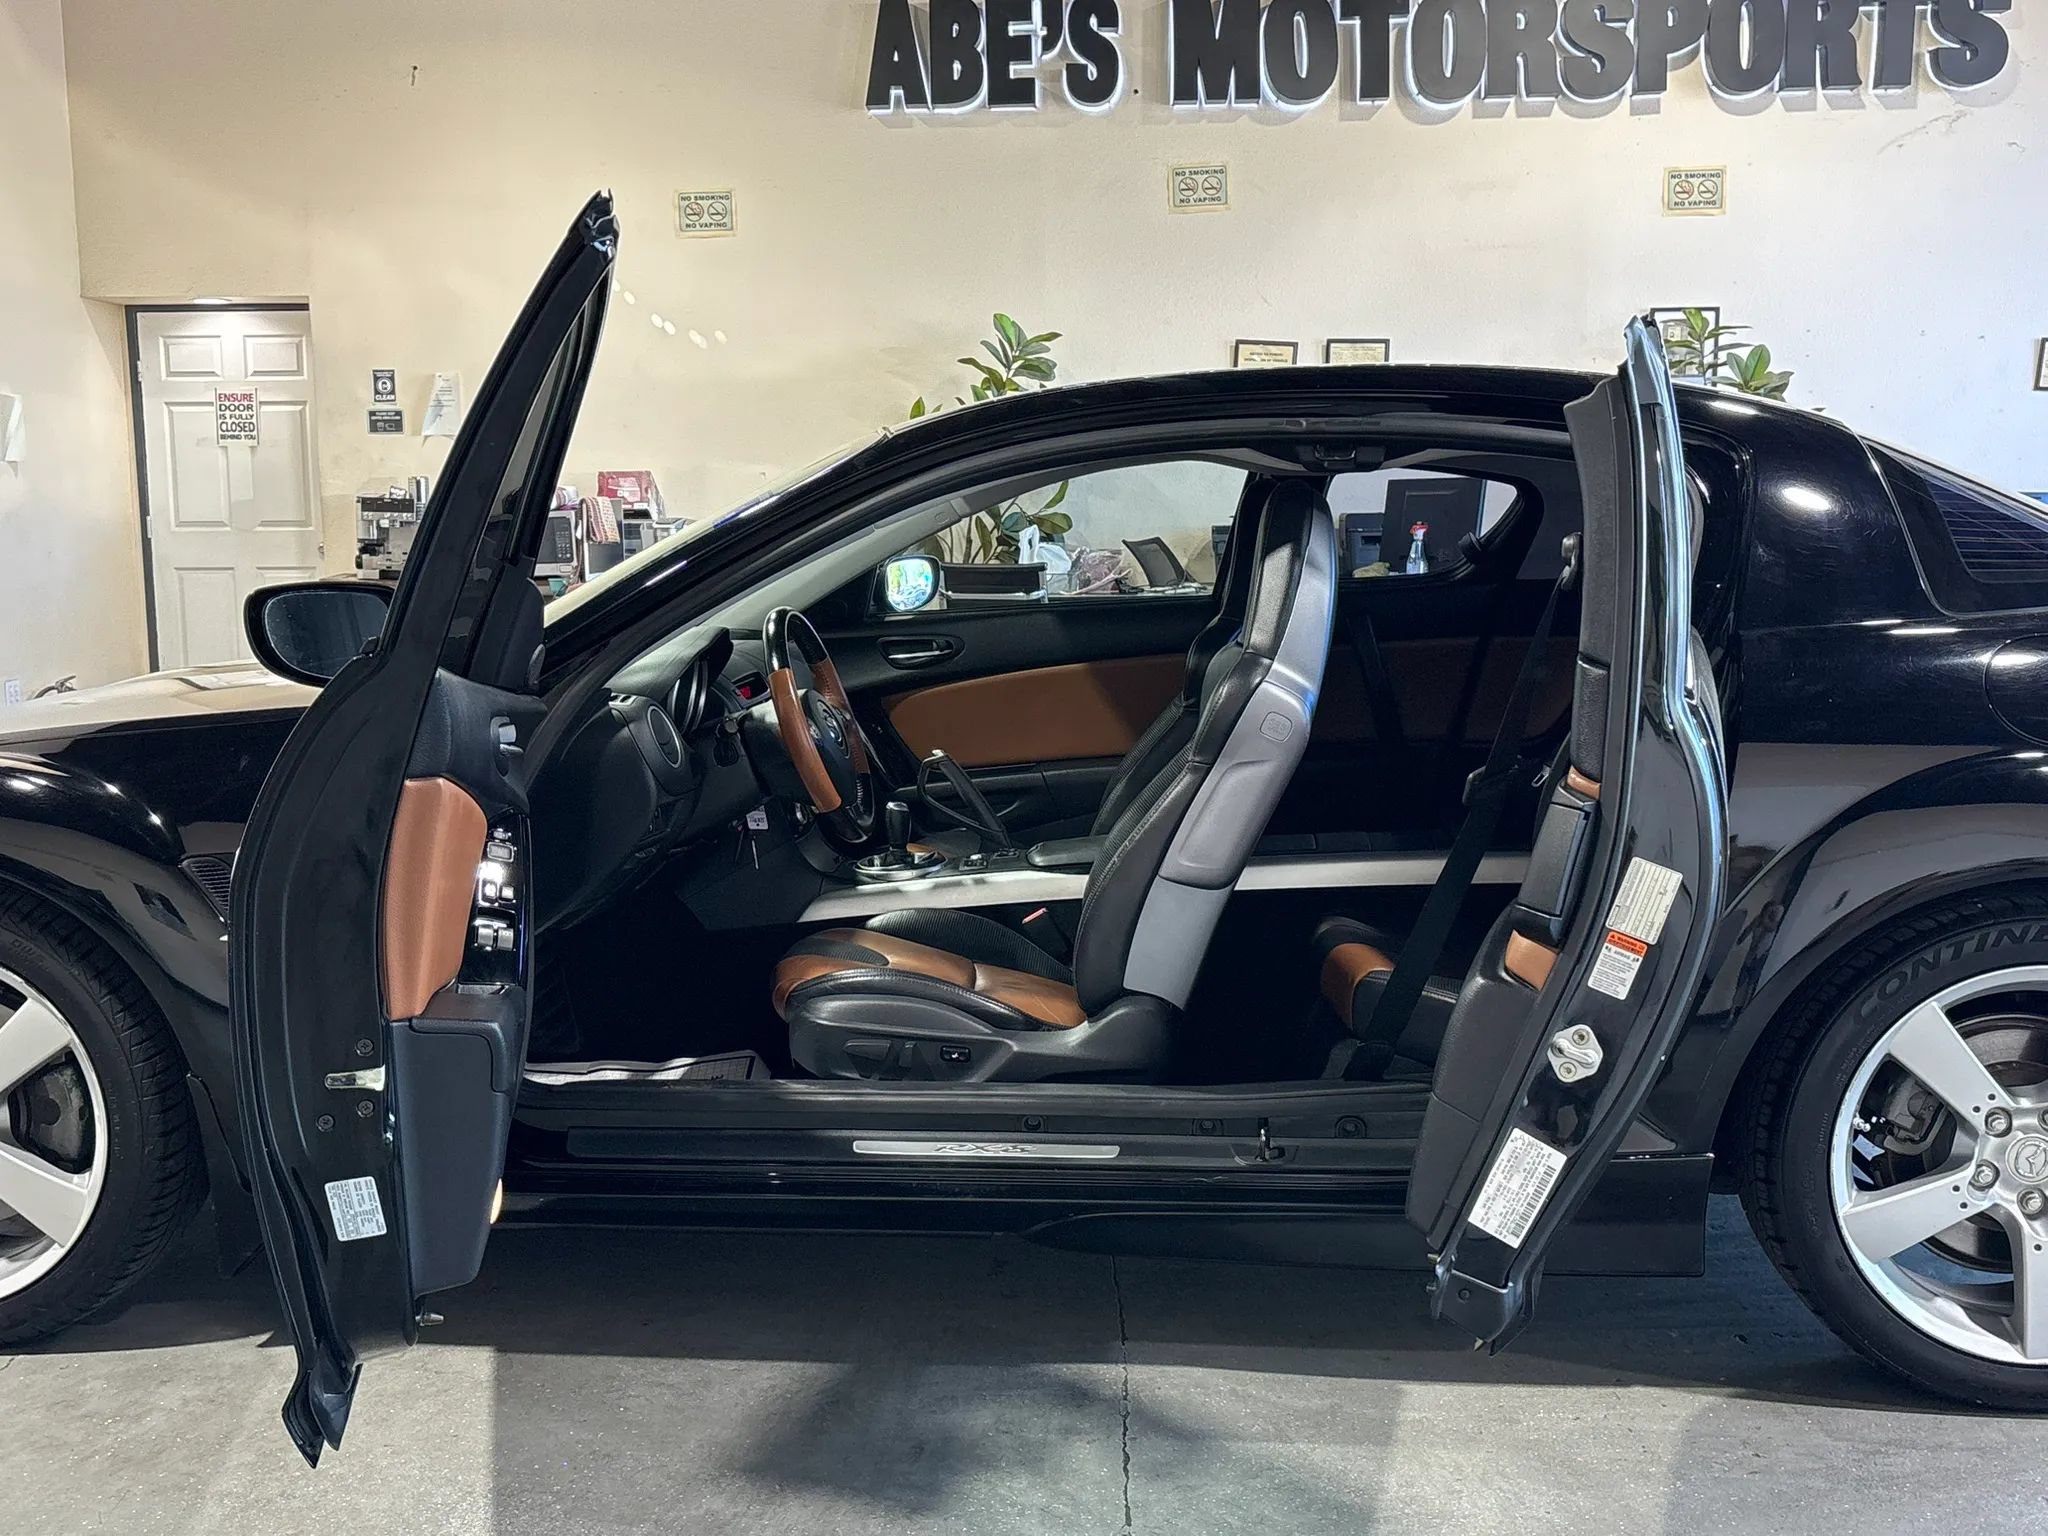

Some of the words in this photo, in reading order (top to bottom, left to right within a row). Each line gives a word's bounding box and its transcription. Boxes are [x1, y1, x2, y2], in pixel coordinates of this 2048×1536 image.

[865, 0, 1122, 112] ABE'S
[1170, 0, 2012, 108] MOTORSPORTS
[1188, 168, 1225, 176] SMOKING
[218, 393, 254, 402] ENSURE
[219, 403, 254, 412] DOOR
[220, 421, 256, 432] CLOSED
